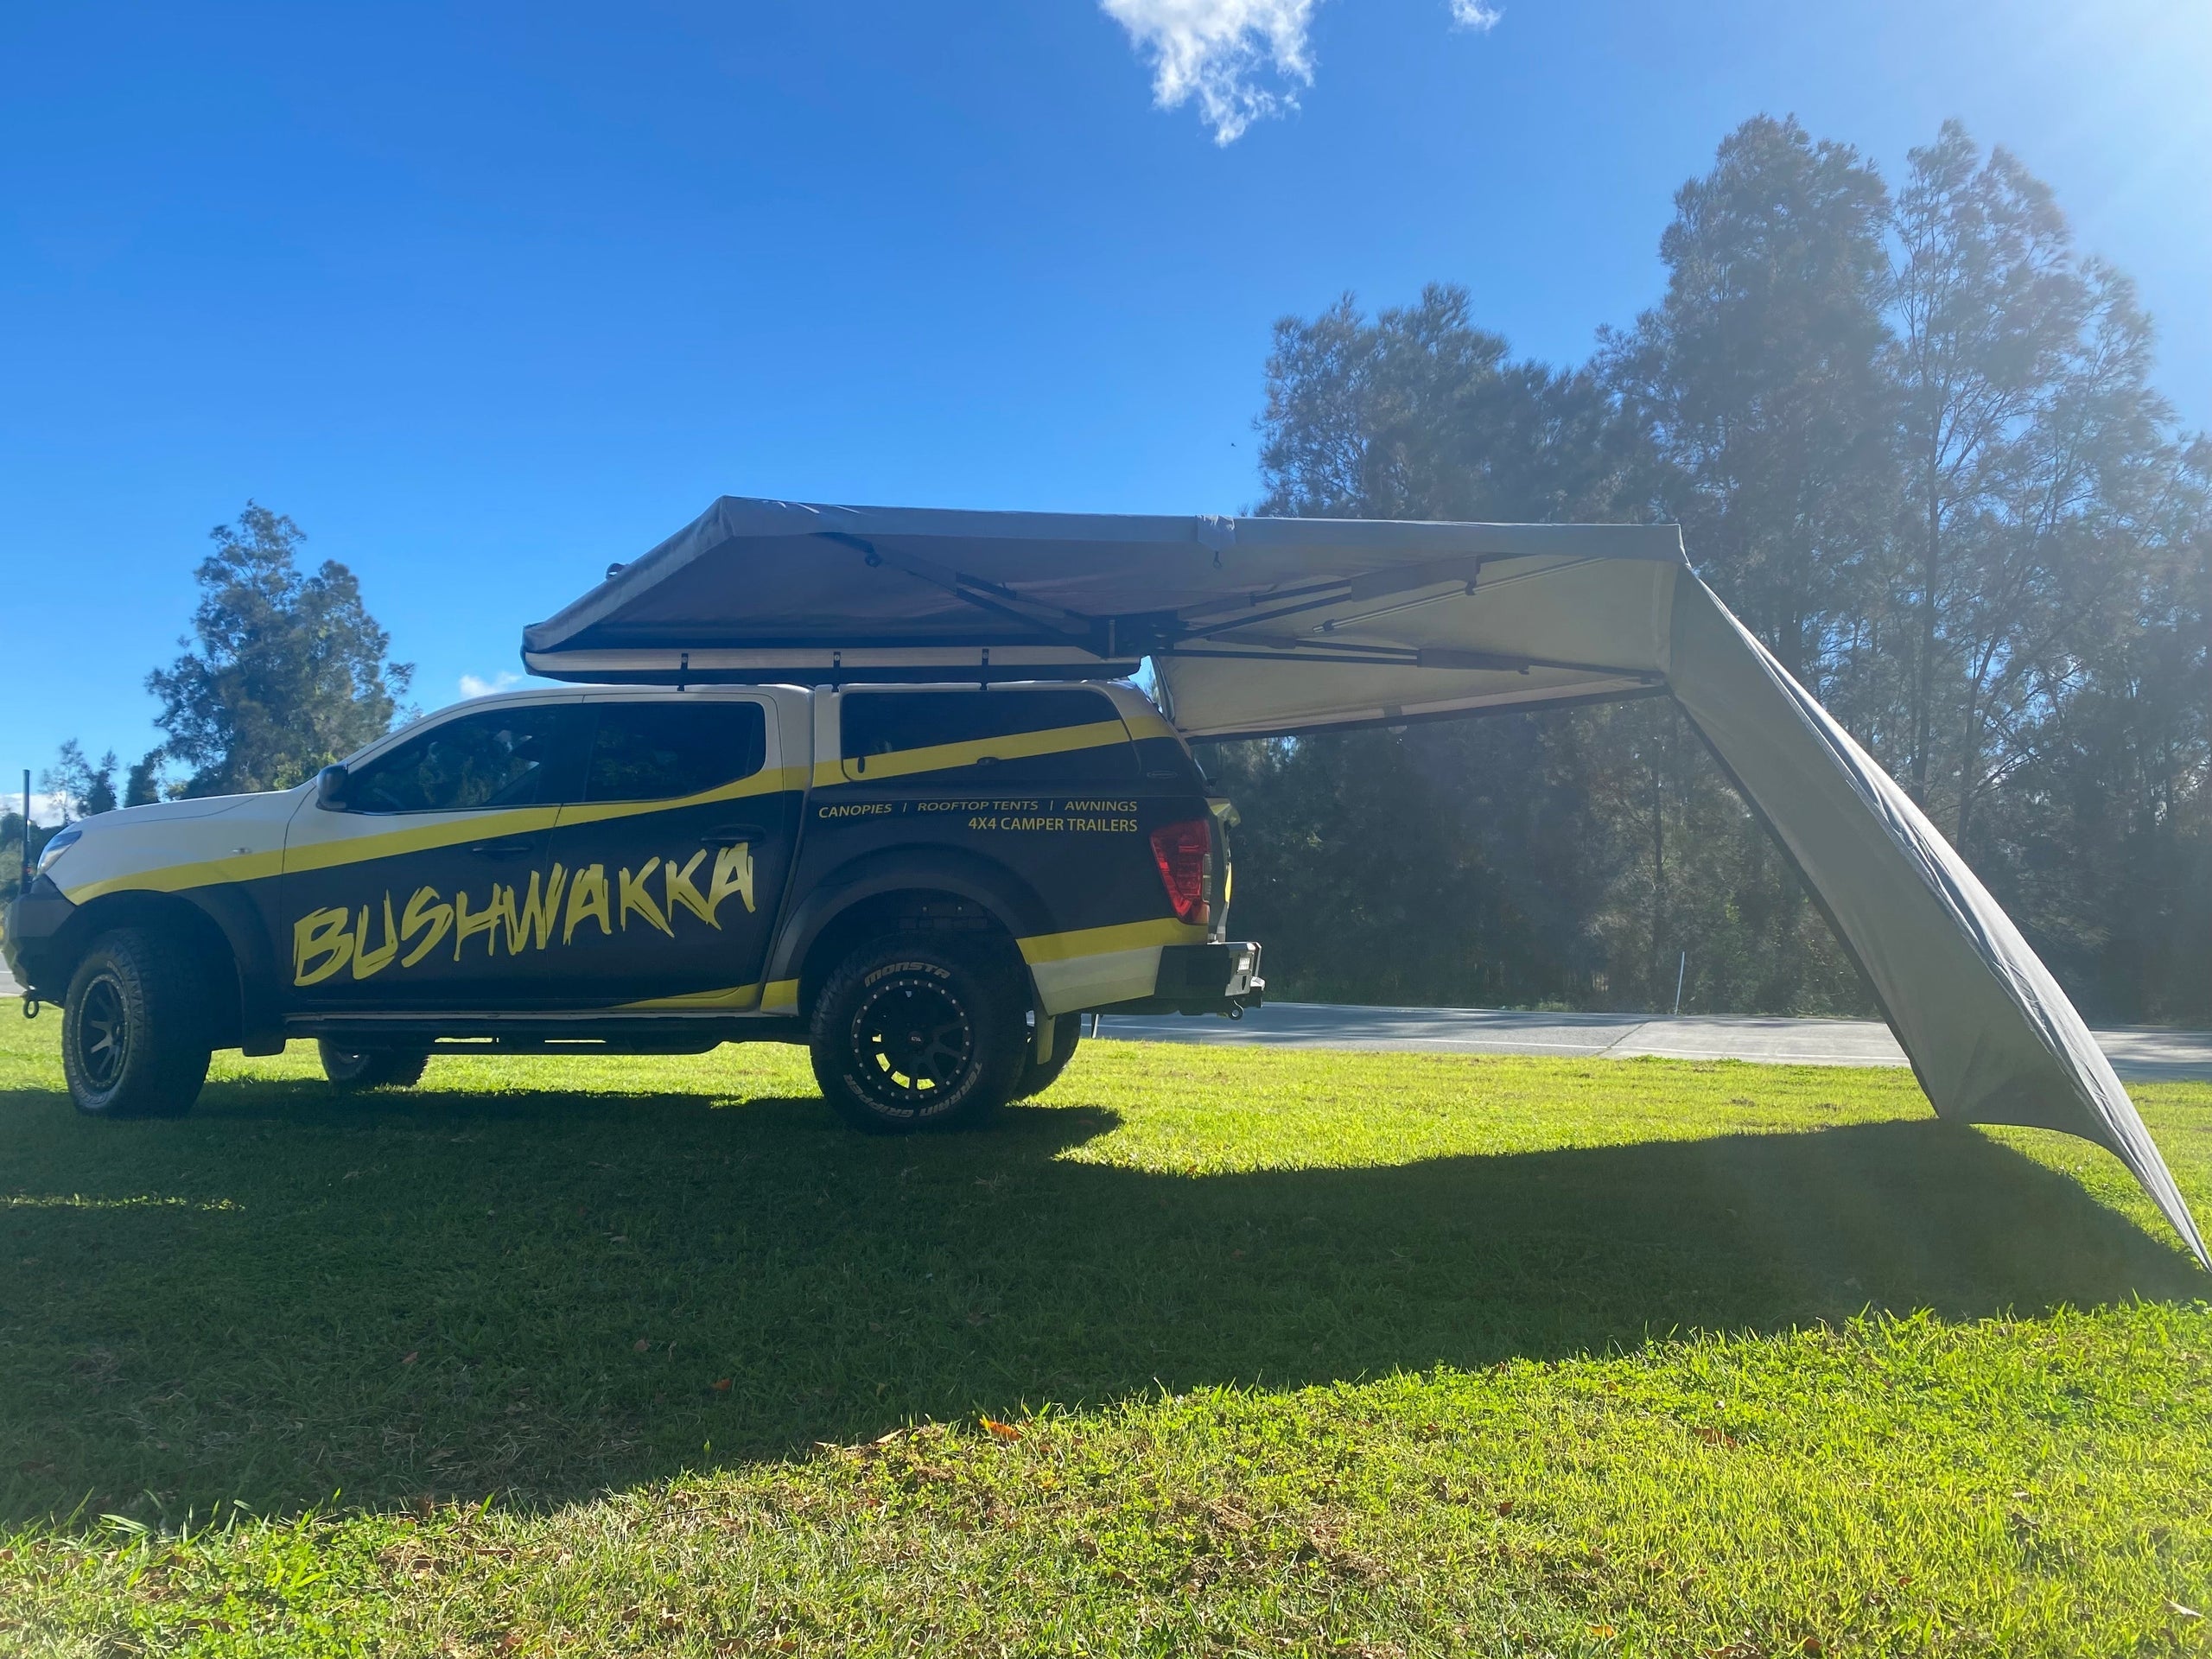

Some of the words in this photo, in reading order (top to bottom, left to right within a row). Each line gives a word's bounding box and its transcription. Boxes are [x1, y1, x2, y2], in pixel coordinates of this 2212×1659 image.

[818, 804, 893, 818] CANOPIES
[917, 801, 989, 811] ROOFTOP
[992, 800, 1039, 810] TENTS
[1064, 801, 1138, 812] AWNINGS
[968, 817, 996, 830] 4X4
[1000, 817, 1064, 830] CAMPER
[1066, 818, 1138, 832] TRAILERS
[293, 842, 756, 987] BUSHWAKKA
[864, 961, 951, 988] MONSTA
[842, 1073, 914, 1118] GRIPPER
[918, 1062, 982, 1117] TERRAIN
